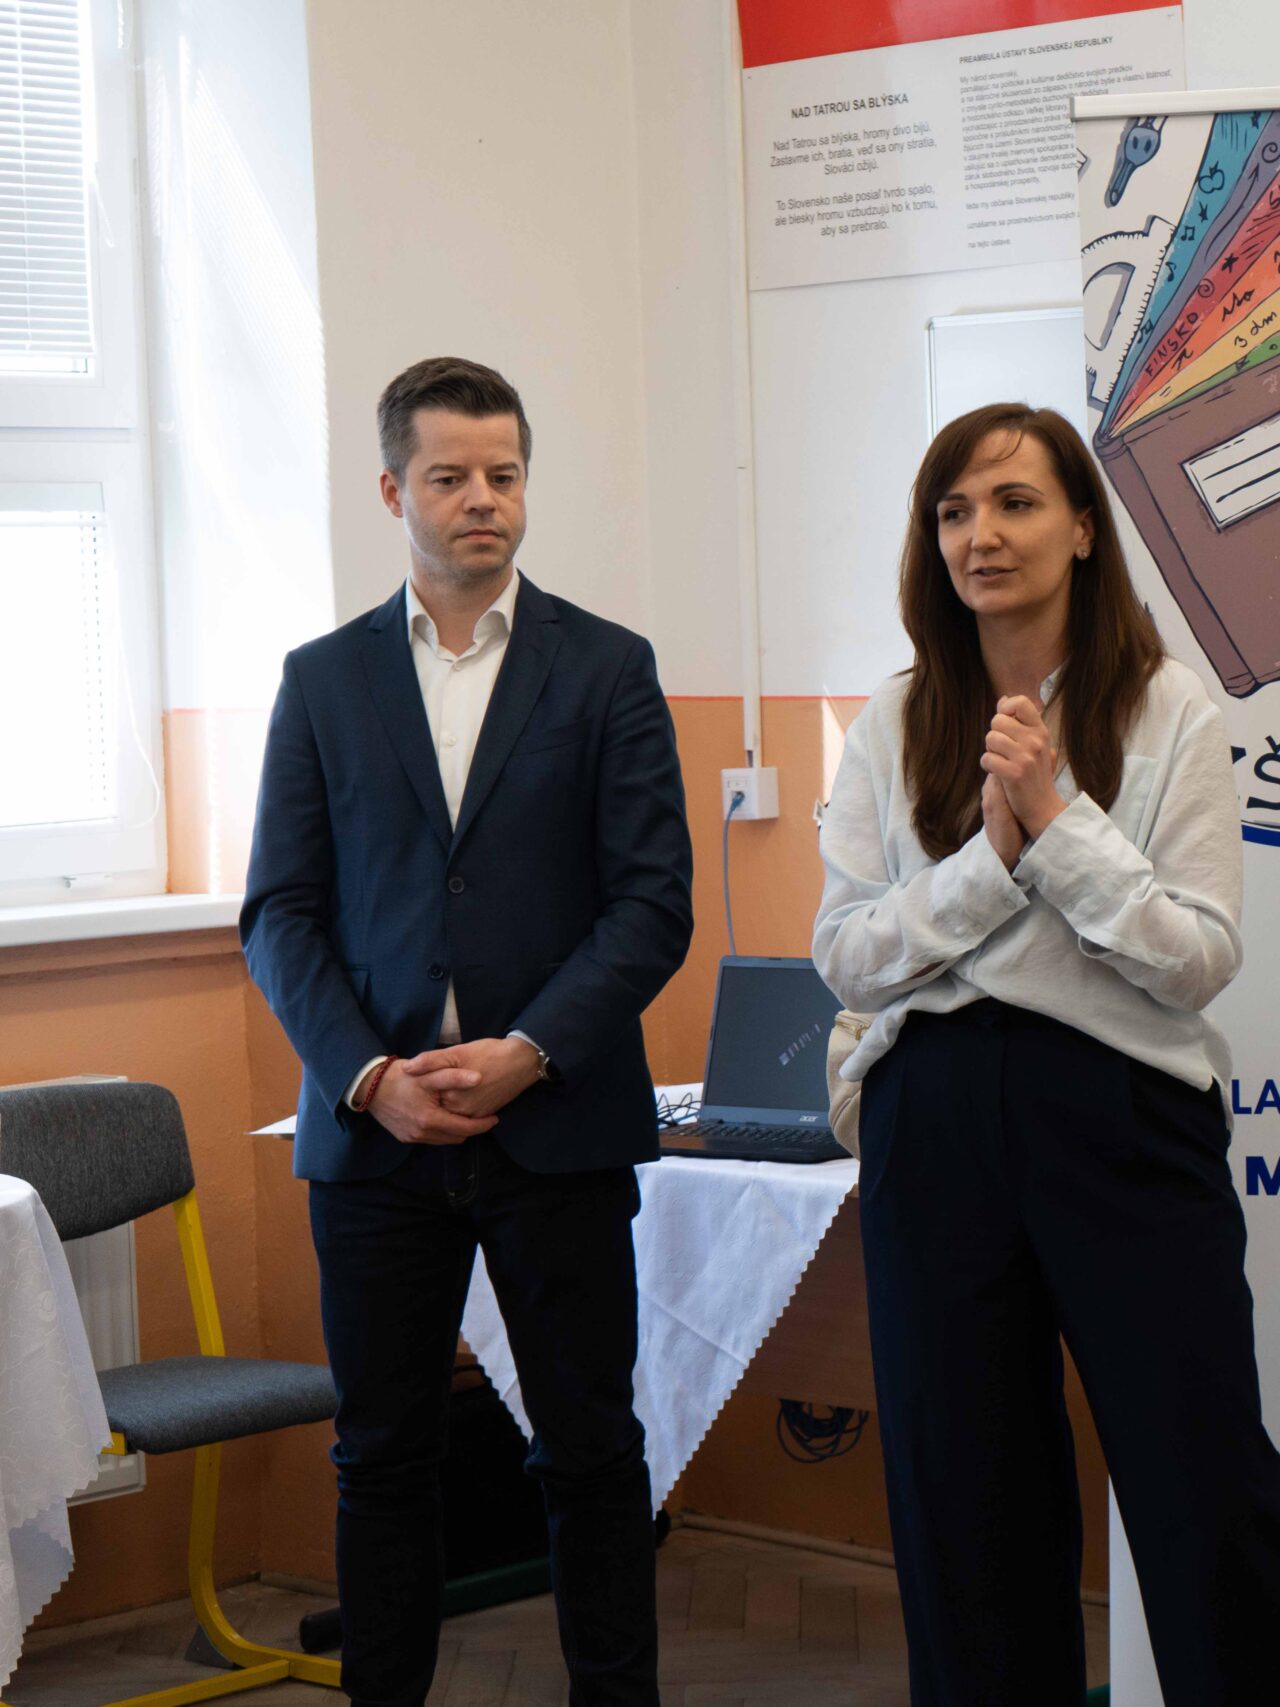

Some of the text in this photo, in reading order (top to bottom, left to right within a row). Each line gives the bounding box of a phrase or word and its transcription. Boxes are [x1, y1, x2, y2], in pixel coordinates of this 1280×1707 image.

[959, 52, 1001, 64] PREAMBULA
[1029, 41, 1073, 55] SLOVENSKEJ
[1074, 36, 1113, 48] REPUBLIKY
[791, 93, 909, 118] NAD TATROU SA BLÝSKA
[773, 141, 790, 151] Nad
[791, 137, 817, 149] Tatrou
[819, 136, 829, 145] sa
[863, 128, 890, 141] hromy
[892, 125, 911, 136] divo
[770, 154, 809, 167] Zastavme
[876, 144, 886, 153] sa
[887, 141, 905, 153] ony
[824, 163, 855, 175] Slováci
[776, 200, 786, 211] To
[788, 195, 831, 210] Slovensko
[832, 192, 853, 204] naše
[883, 186, 906, 198] tvrdo
[907, 183, 935, 197] spalo,
[775, 216, 787, 226] ale
[789, 212, 815, 225] blesky
[817, 209, 844, 221] hromu
[846, 203, 889, 219] vzbudzujú
[891, 201, 903, 213] ho
[821, 219, 888, 237] aby sa prebralo.
